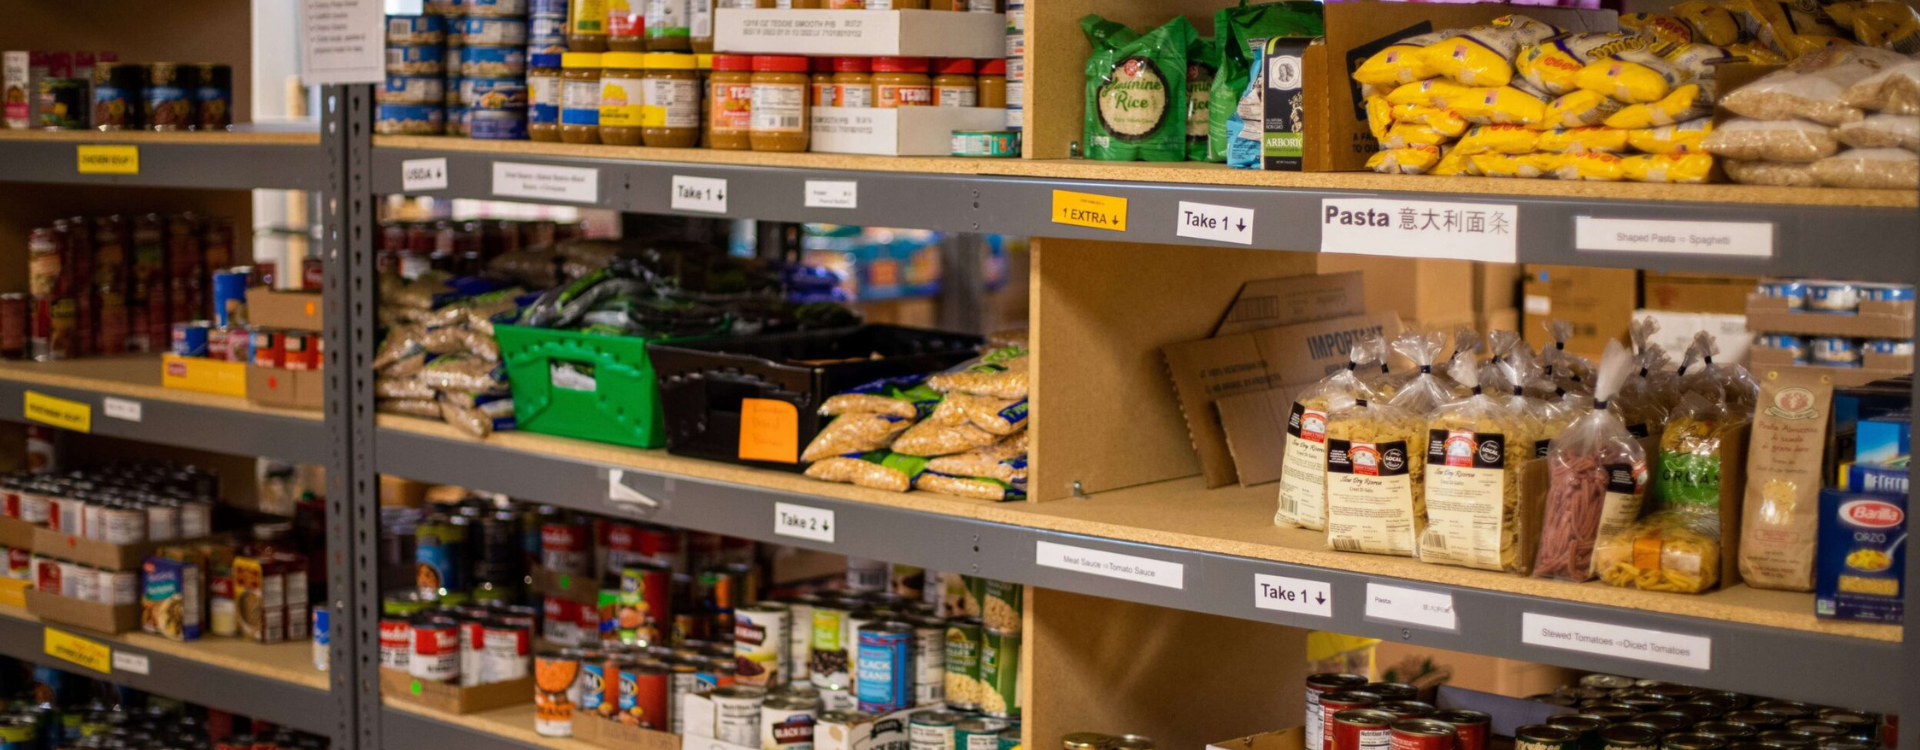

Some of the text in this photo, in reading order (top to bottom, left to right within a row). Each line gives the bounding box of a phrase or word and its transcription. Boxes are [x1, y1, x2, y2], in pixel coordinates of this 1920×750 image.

[1101, 76, 1162, 97] Jasmine
[1115, 90, 1149, 112] Rice
[405, 167, 431, 181] USDA
[678, 185, 711, 201] Take 1
[1062, 207, 1107, 225] 1 EXTRA
[1184, 211, 1228, 230] Take 1
[1325, 205, 1509, 235] Pasta 意大利面条
[1616, 232, 1731, 246] Shaped Pasta Spaghetti
[1758, 421, 1779, 431] Pasta
[1481, 447, 1498, 456] LOCAL
[1353, 476, 1363, 487] Dry
[780, 512, 817, 530] Take 2
[1853, 506, 1900, 522] Barilla
[1854, 532, 1887, 543] ORZO
[1063, 555, 1156, 577] Meat Sauce Tomato Sauce
[1261, 582, 1309, 604] Take 1
[1374, 596, 1392, 605] Pasta
[1541, 628, 1691, 657] Stewed Tomatoes Diced Tomatoes
[860, 658, 891, 670] LACK
[860, 669, 891, 681] EANS
